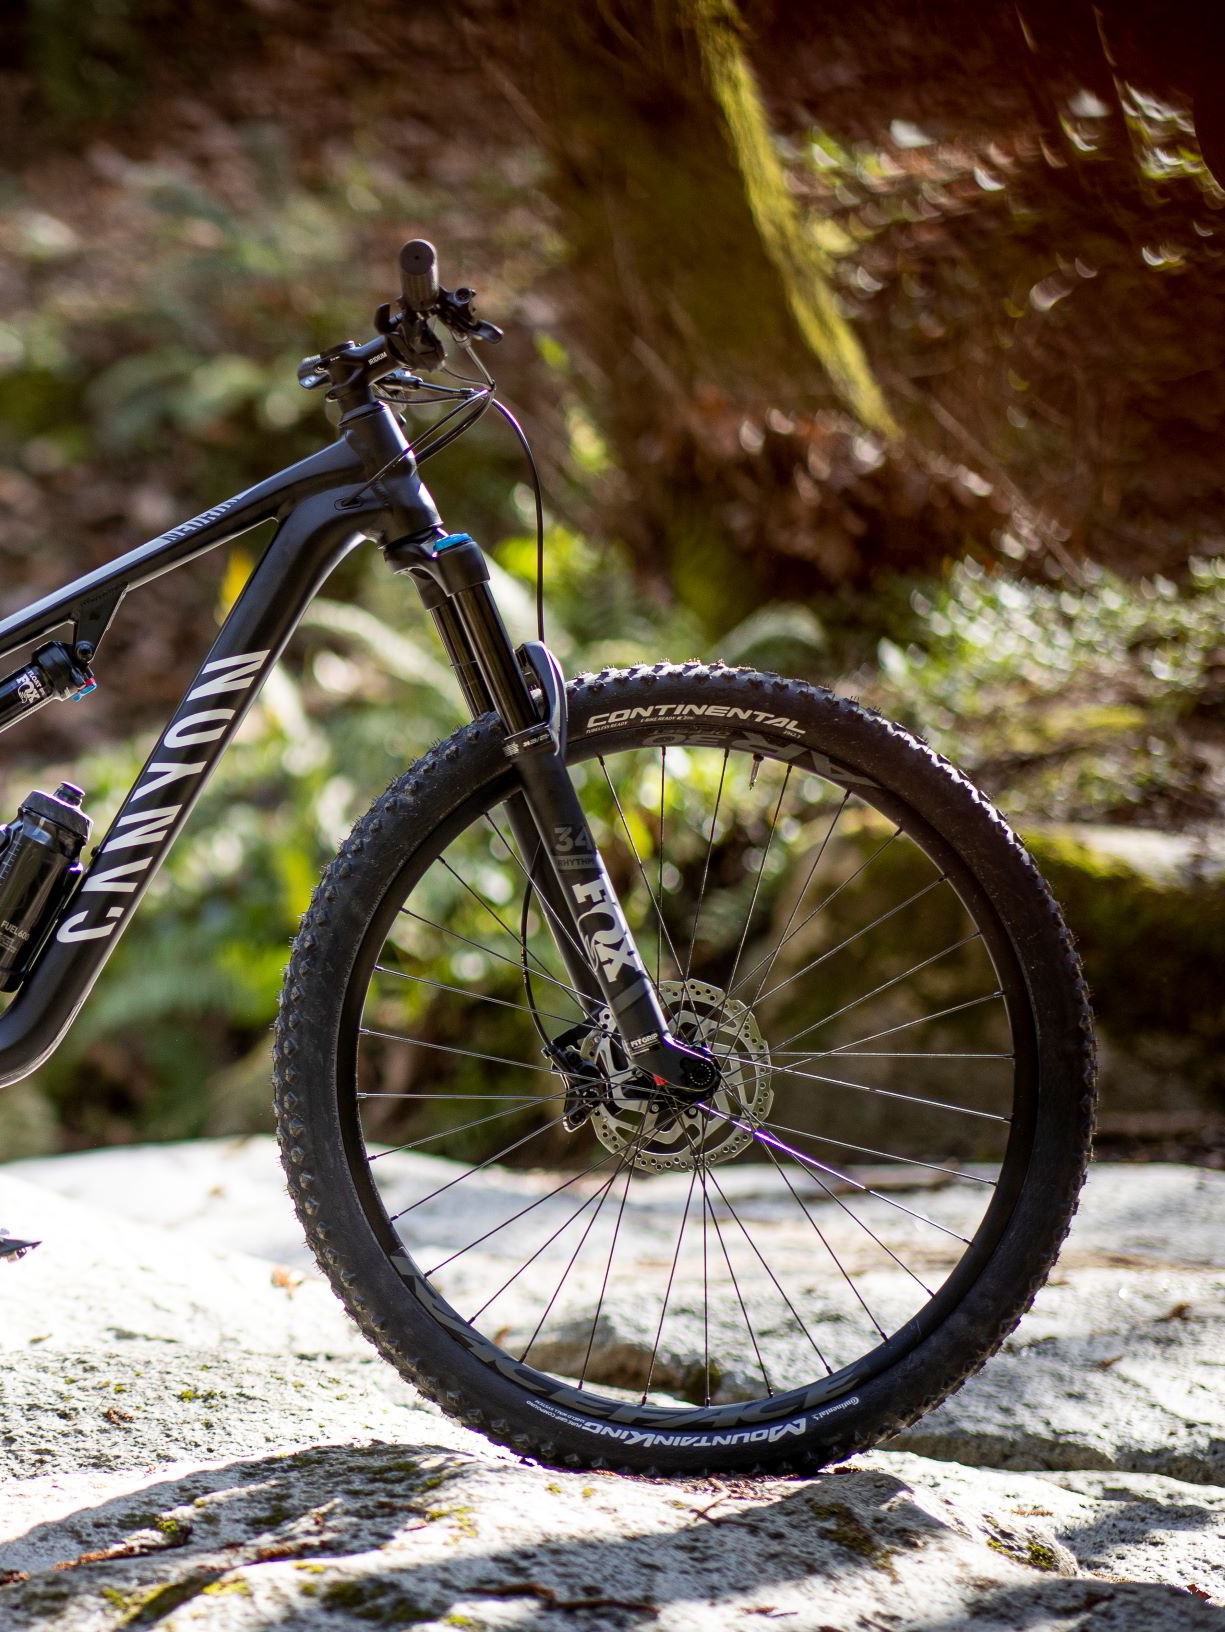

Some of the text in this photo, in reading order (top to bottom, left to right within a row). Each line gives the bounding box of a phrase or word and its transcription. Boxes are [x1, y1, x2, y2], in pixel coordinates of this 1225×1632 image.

[15, 674, 41, 704] FOX
[587, 703, 807, 734] CONTINENTAL
[56, 649, 272, 944] CANYON
[554, 826, 593, 852] 34
[572, 873, 646, 983] FOX
[818, 1396, 860, 1419] Continental
